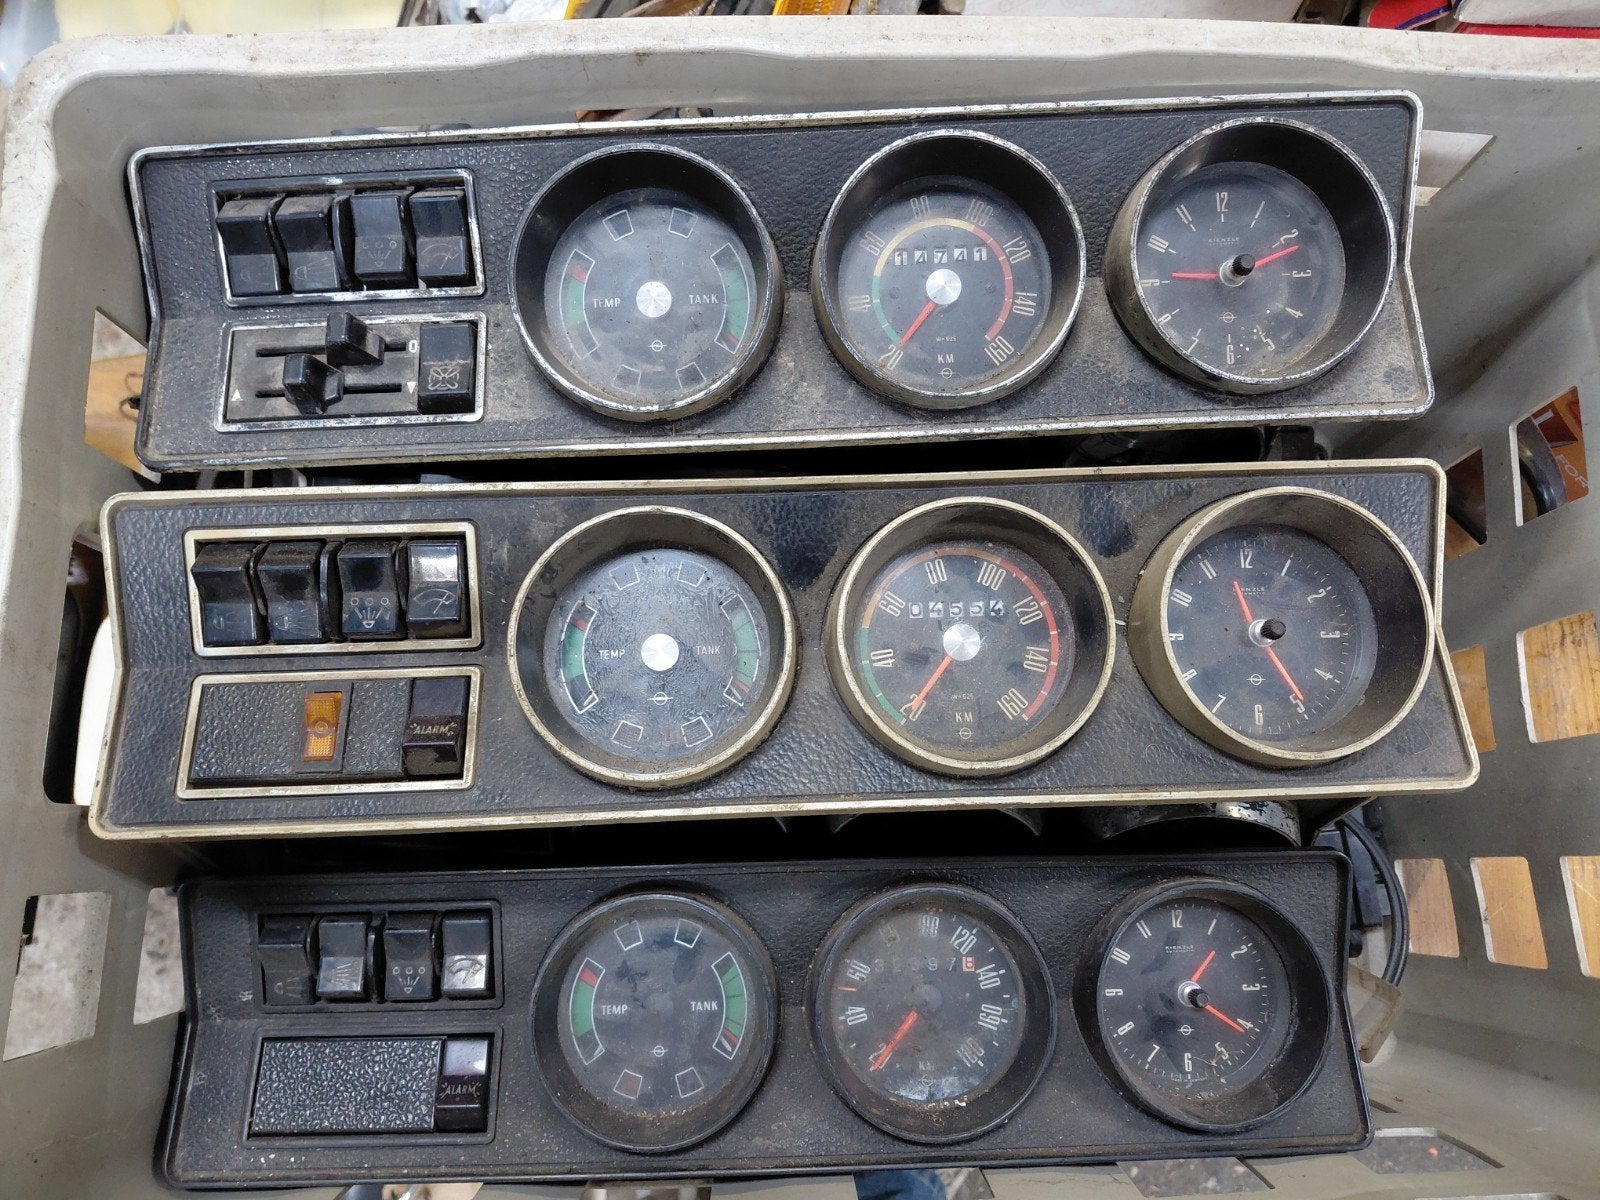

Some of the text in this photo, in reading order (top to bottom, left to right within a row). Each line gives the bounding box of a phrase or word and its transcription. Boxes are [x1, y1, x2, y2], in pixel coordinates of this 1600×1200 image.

[1216, 191, 1229, 212] 12
[859, 230, 886, 256] 60
[1147, 234, 1169, 253] 10
[1279, 228, 1299, 244] 2
[1002, 235, 1032, 265] 120
[1292, 269, 1312, 278] 3
[593, 297, 621, 309] TEMP
[689, 294, 719, 305] TANK
[849, 294, 871, 313] 40
[1012, 291, 1038, 317] 140
[1285, 307, 1304, 319] 4
[983, 335, 1015, 367] 160
[1261, 332, 1276, 351] 5
[878, 343, 904, 371] 20
[937, 353, 954, 364] KM
[1226, 344, 1235, 365] 6
[1240, 548, 1253, 569] 12
[924, 559, 948, 585] 80
[977, 561, 1007, 591] 100
[879, 591, 906, 617] 60
[1170, 588, 1193, 607] 10
[1306, 588, 1327, 604] 2
[1012, 595, 1043, 626] 120
[1320, 630, 1341, 639] 3
[598, 649, 626, 660] TEMP
[695, 645, 721, 655] TANK
[870, 648, 896, 668] 40
[1023, 645, 1049, 673] 140
[1314, 668, 1333, 681] 4
[899, 693, 927, 722] 20
[997, 688, 1029, 721] 160
[1212, 693, 1227, 714] 7
[1289, 693, 1306, 714] 5
[955, 711, 973, 723] KM
[1254, 704, 1264, 725] 6
[413, 725, 450, 735] ALARM
[1171, 909, 1183, 928] 12
[950, 925, 977, 955] 120
[1110, 947, 1131, 965] 10
[1230, 944, 1248, 960] 2
[846, 959, 871, 983] 60
[975, 963, 1001, 990] 140
[1104, 988, 1124, 997] 9
[1242, 983, 1261, 991] 3
[601, 1004, 628, 1016] TEMP
[690, 1001, 718, 1012] TANK
[845, 1005, 868, 1026] 40
[977, 1003, 1003, 1031] 160
[1236, 1018, 1254, 1030] 4
[1117, 1021, 1135, 1036] 8
[1147, 1044, 1161, 1062] 7
[1214, 1041, 1229, 1061] 5
[1184, 1052, 1193, 1072] 6
[441, 1084, 477, 1098] ALARM
